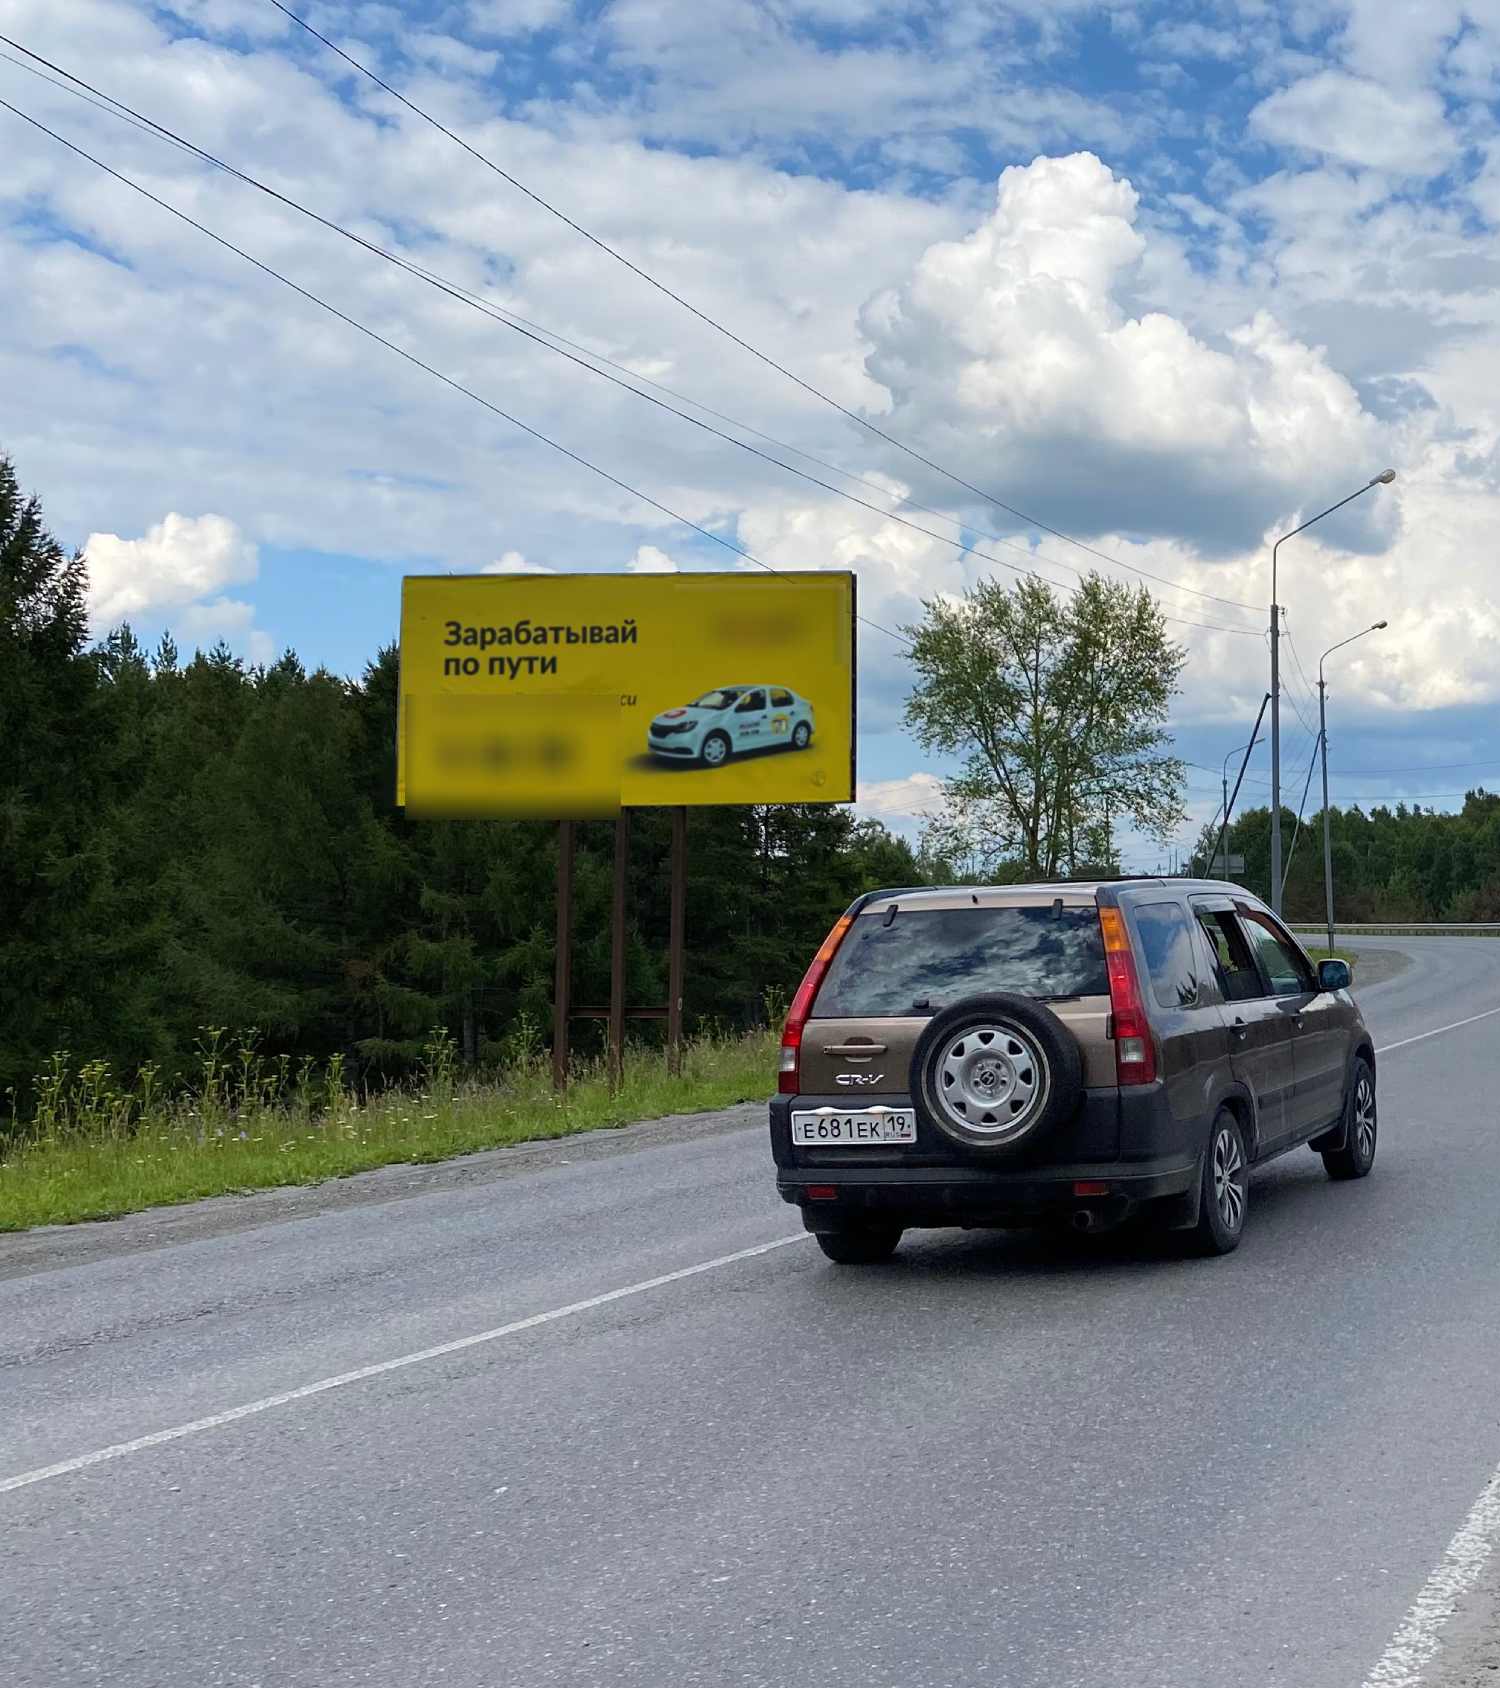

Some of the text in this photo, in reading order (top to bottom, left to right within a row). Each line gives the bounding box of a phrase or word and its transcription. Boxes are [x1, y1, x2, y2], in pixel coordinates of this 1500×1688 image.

[444, 619, 638, 650] Зарабатывай
[444, 655, 558, 680] по пути
[835, 1074, 884, 1085] CR-V
[887, 1115, 905, 1131] 19
